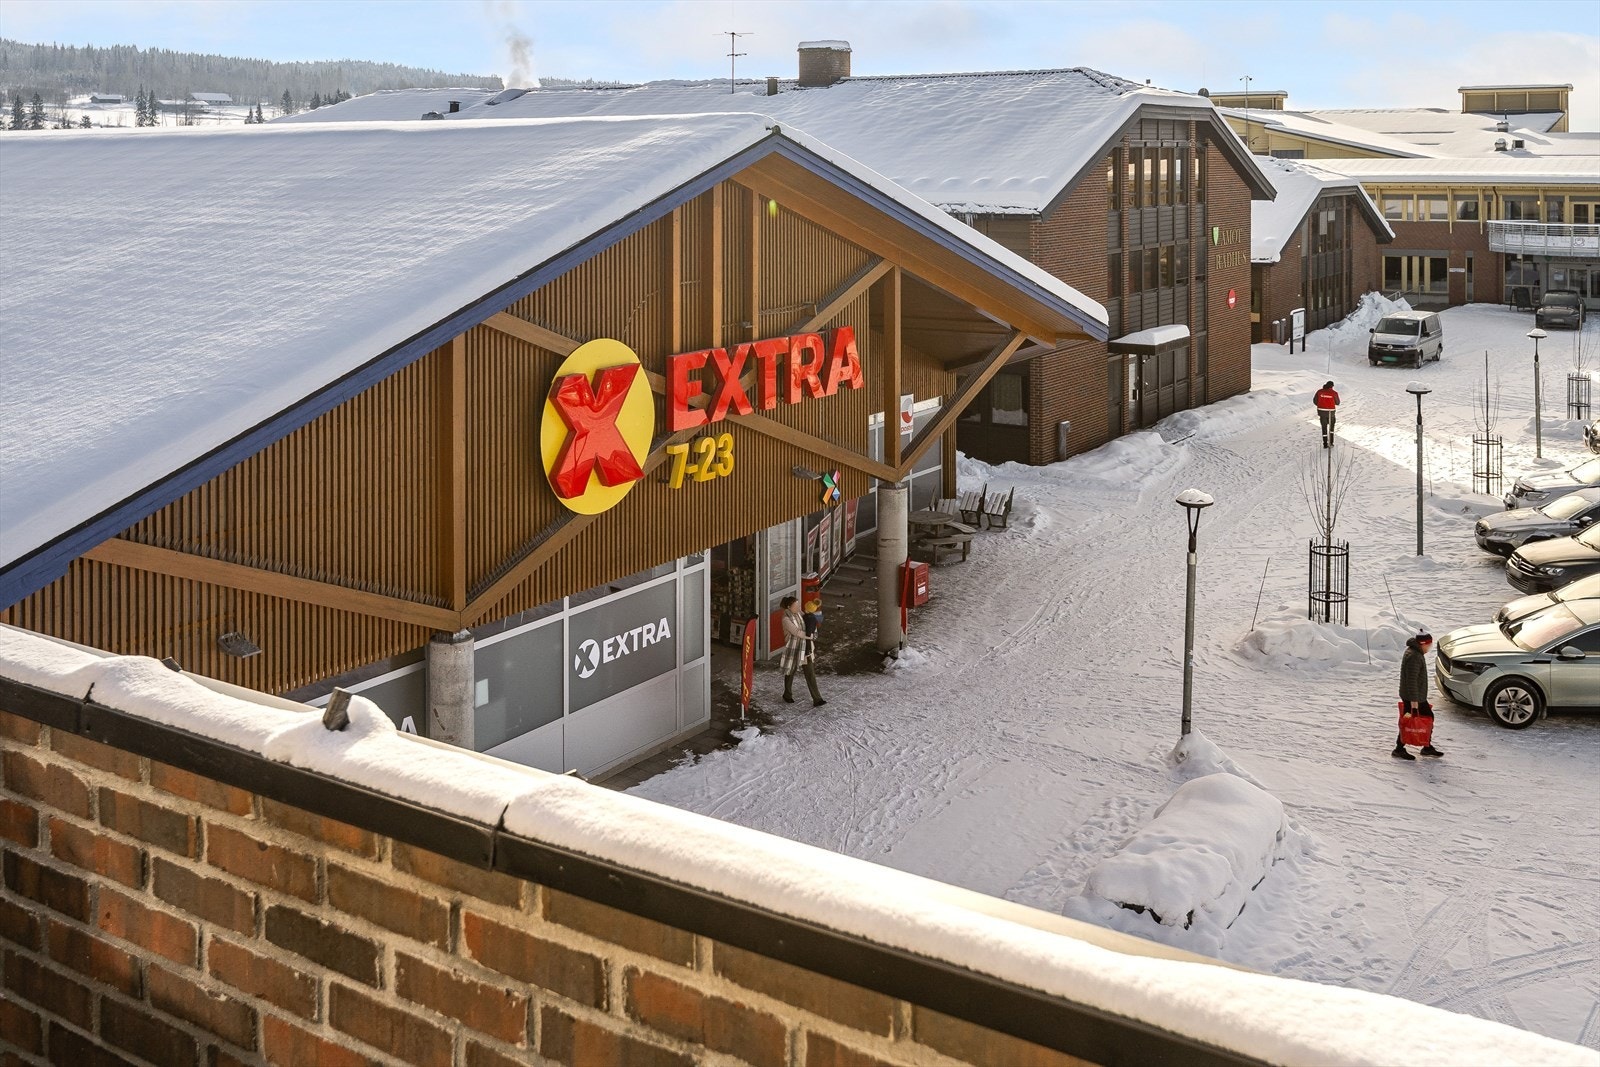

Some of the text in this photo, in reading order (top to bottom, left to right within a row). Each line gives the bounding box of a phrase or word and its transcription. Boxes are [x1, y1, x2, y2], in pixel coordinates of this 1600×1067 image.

[666, 326, 865, 432] EXTRA
[666, 433, 735, 489] 7-23
[602, 617, 671, 664] EXTRA
